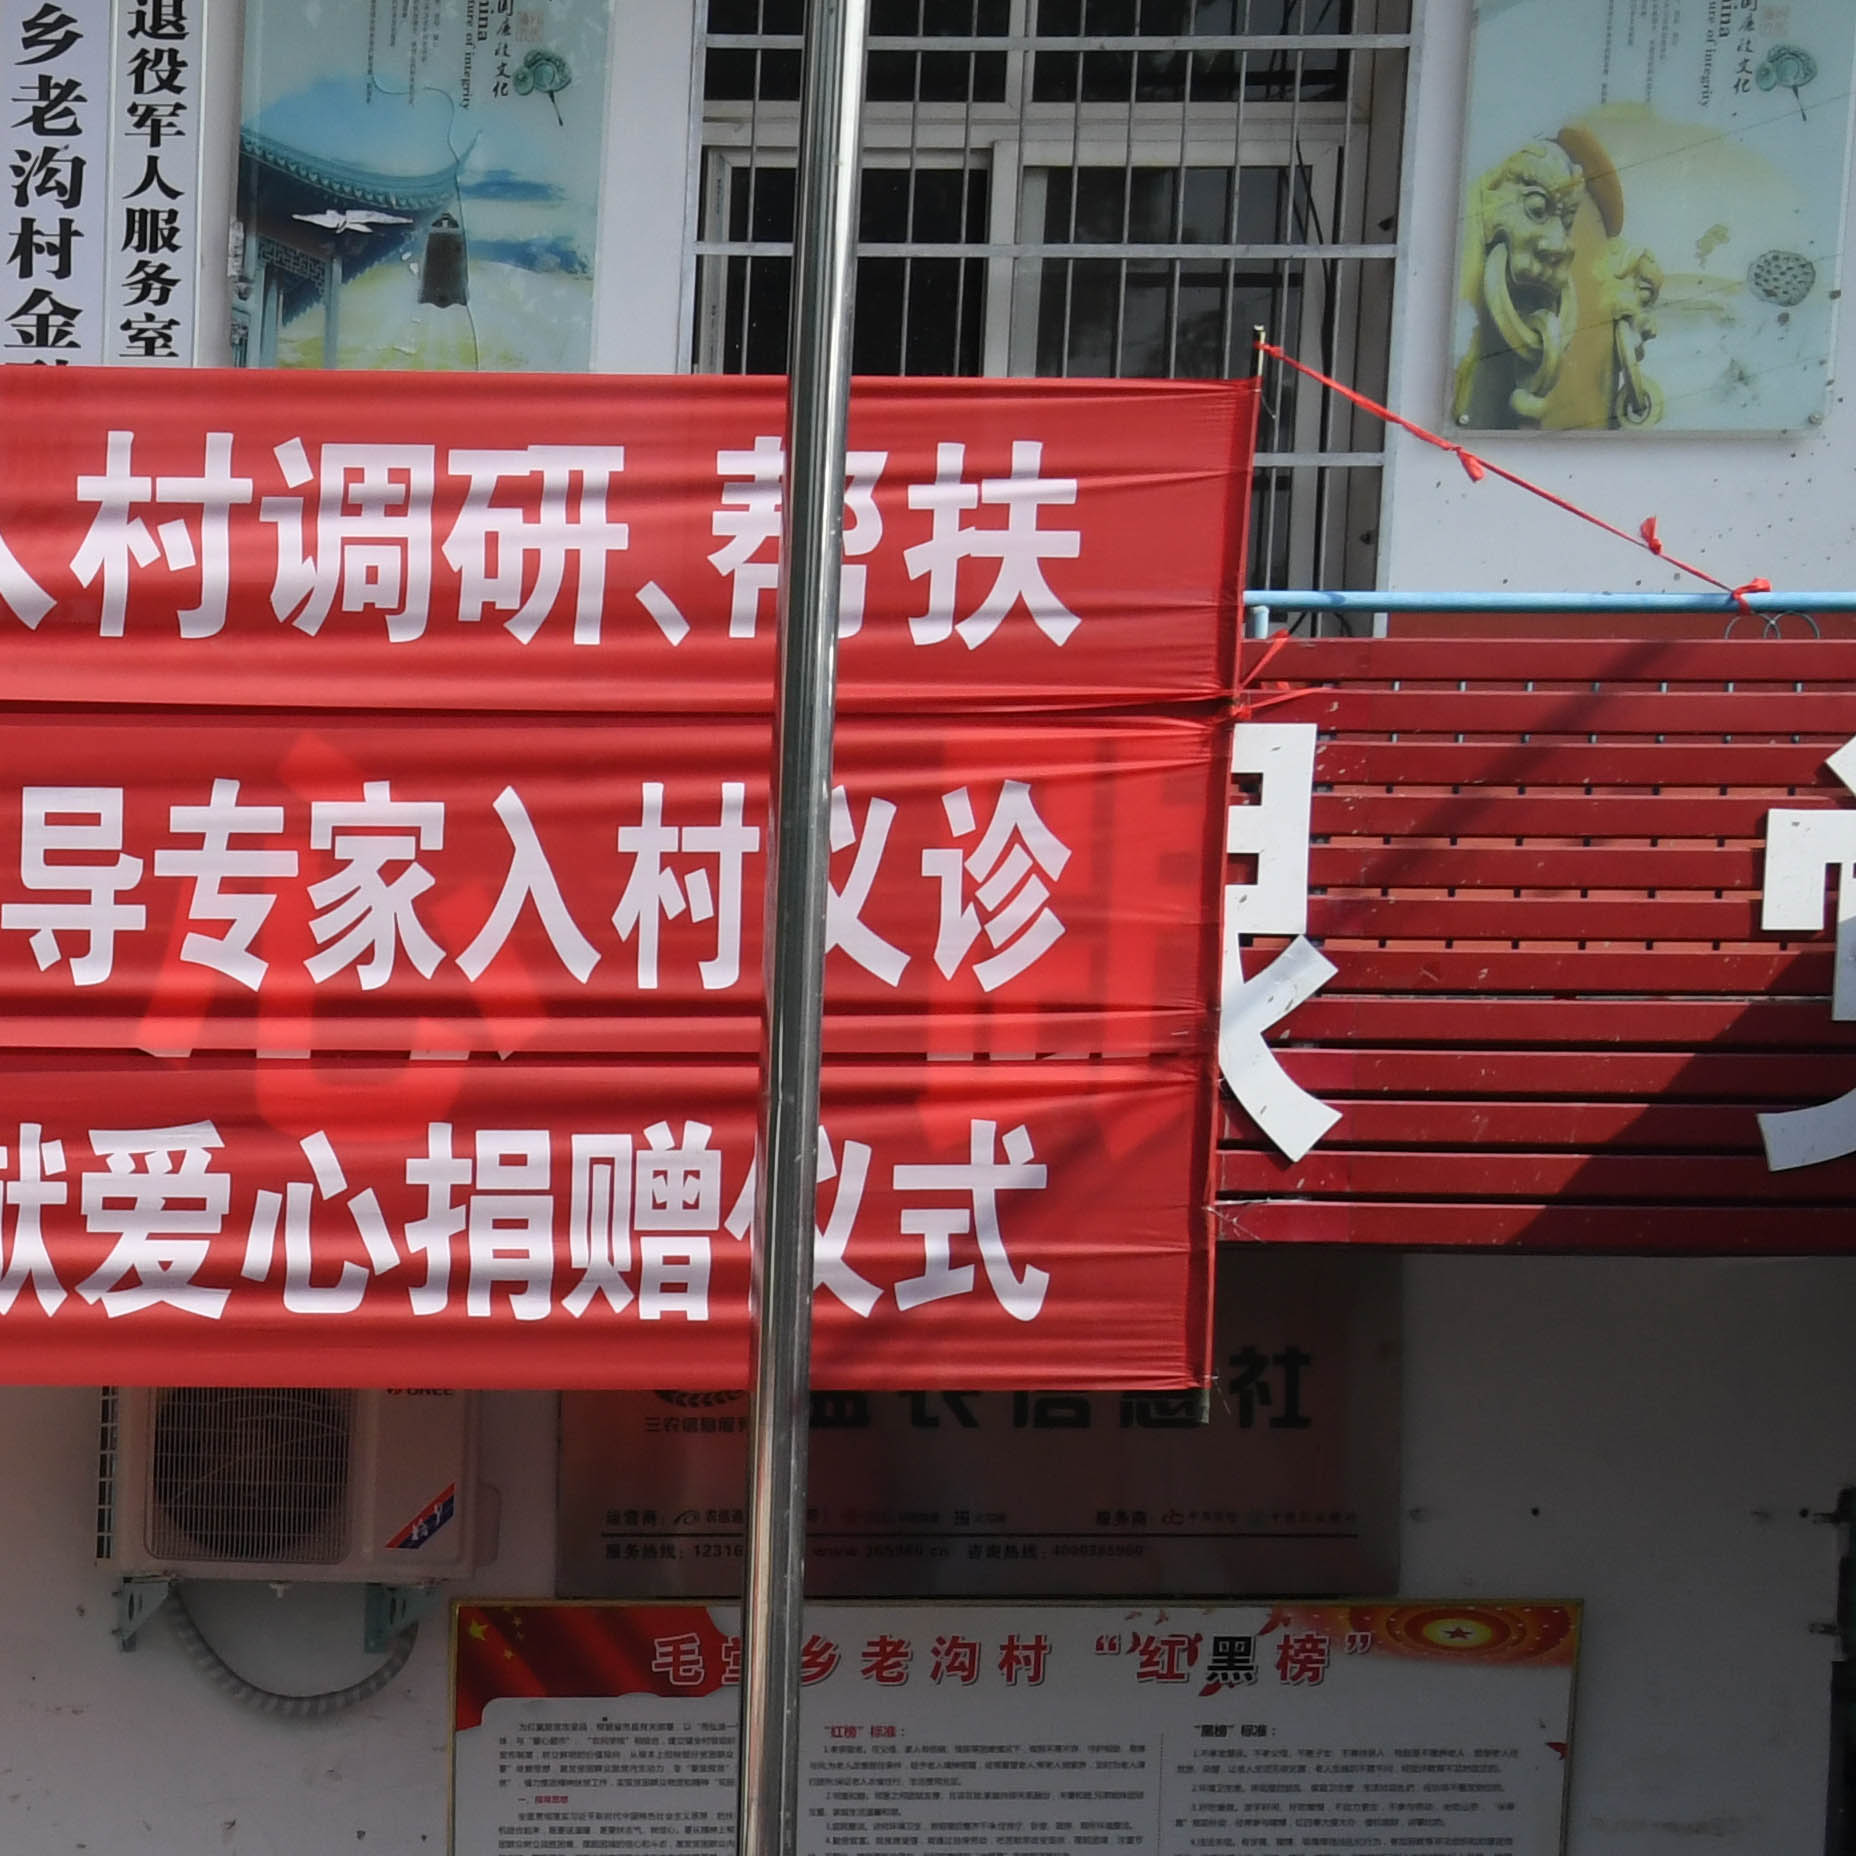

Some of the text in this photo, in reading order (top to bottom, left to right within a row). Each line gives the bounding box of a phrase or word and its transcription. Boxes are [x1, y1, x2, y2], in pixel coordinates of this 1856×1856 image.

[3, 3, 88, 365] 乡老沟村金
[119, 0, 190, 358] 退役军人服务室
